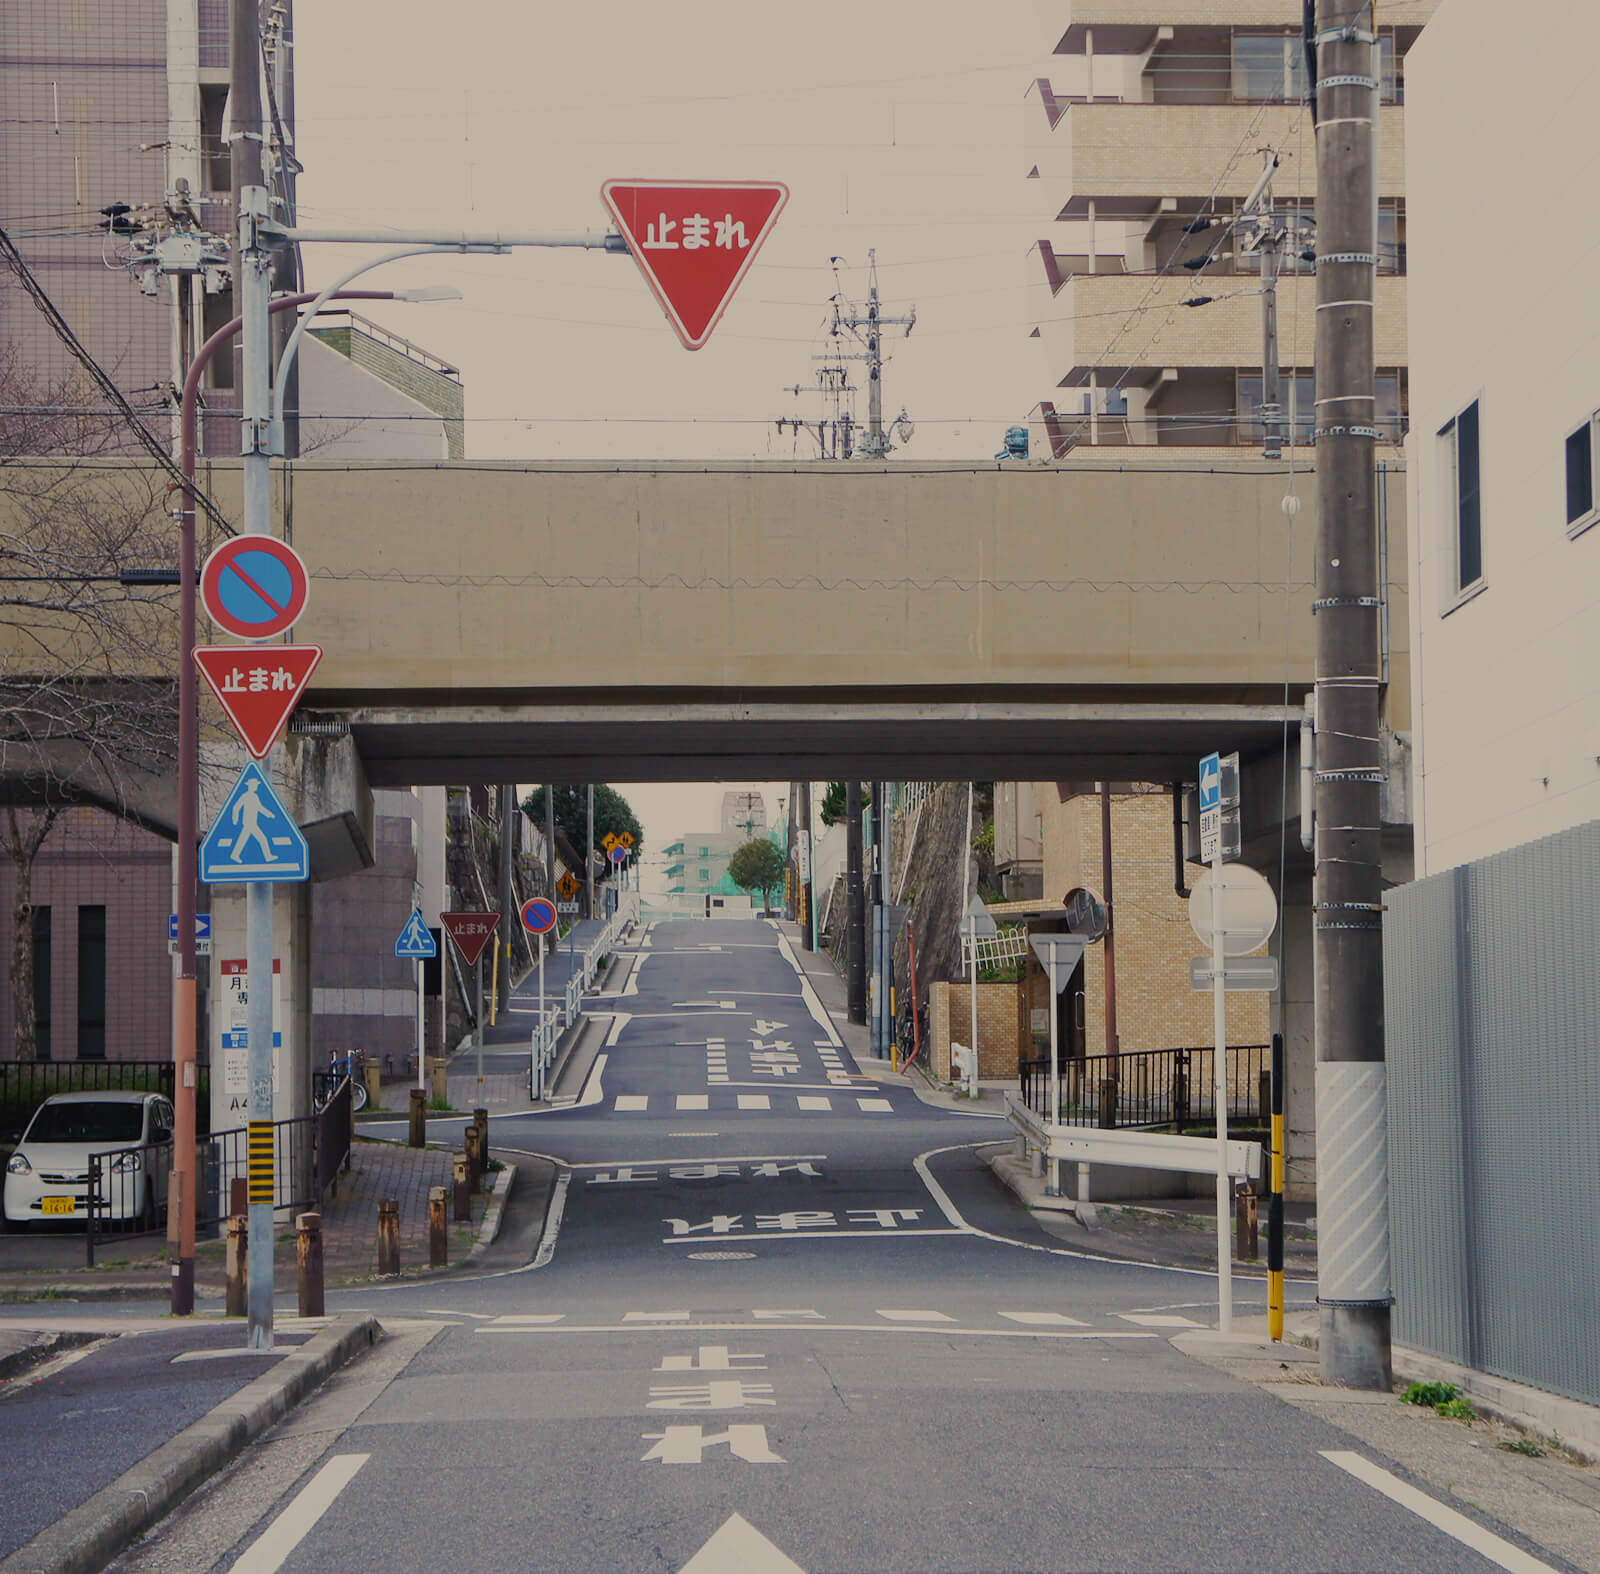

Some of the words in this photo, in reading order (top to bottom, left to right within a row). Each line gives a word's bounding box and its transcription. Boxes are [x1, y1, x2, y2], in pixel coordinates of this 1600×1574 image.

[641, 212, 751, 250] 止まれ
[220, 666, 297, 692] 止まれ
[455, 921, 489, 935] 止まれ
[586, 1161, 824, 1185] 止まれ
[662, 1208, 924, 1236] 止まれ
[640, 1345, 789, 1465] 止まれ
